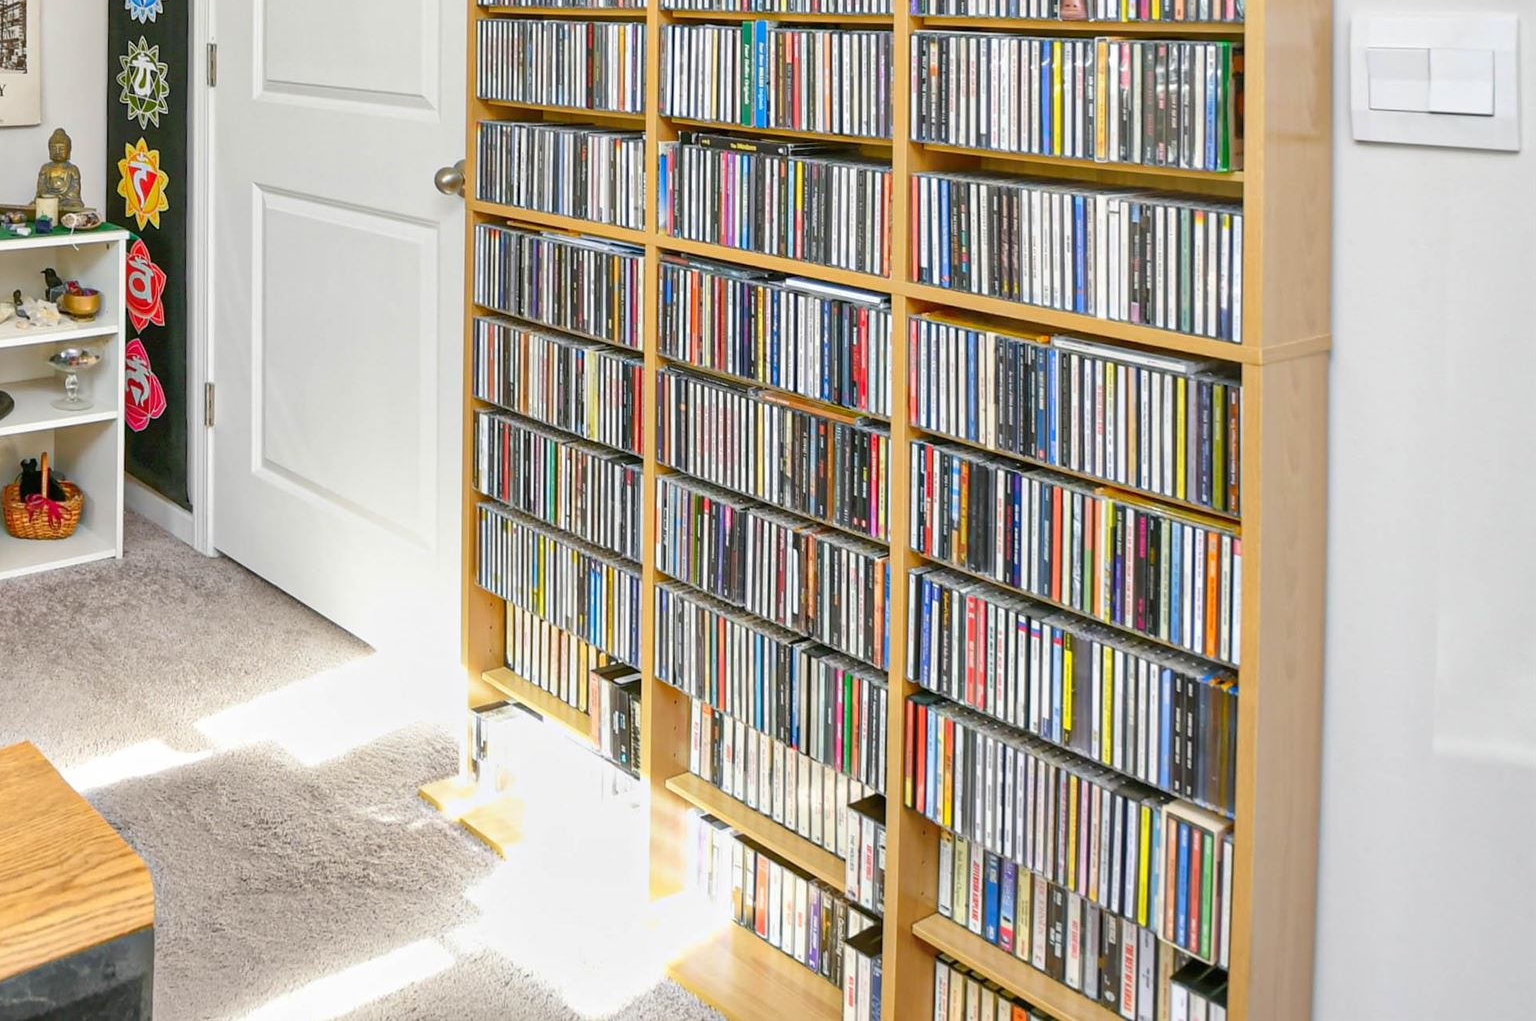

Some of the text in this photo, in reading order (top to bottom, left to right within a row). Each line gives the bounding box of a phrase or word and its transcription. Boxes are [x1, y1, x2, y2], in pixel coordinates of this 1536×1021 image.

[972, 860, 982, 922] JEFFERSON AIRPLANE
[1124, 983, 1134, 1012] KANSAS
